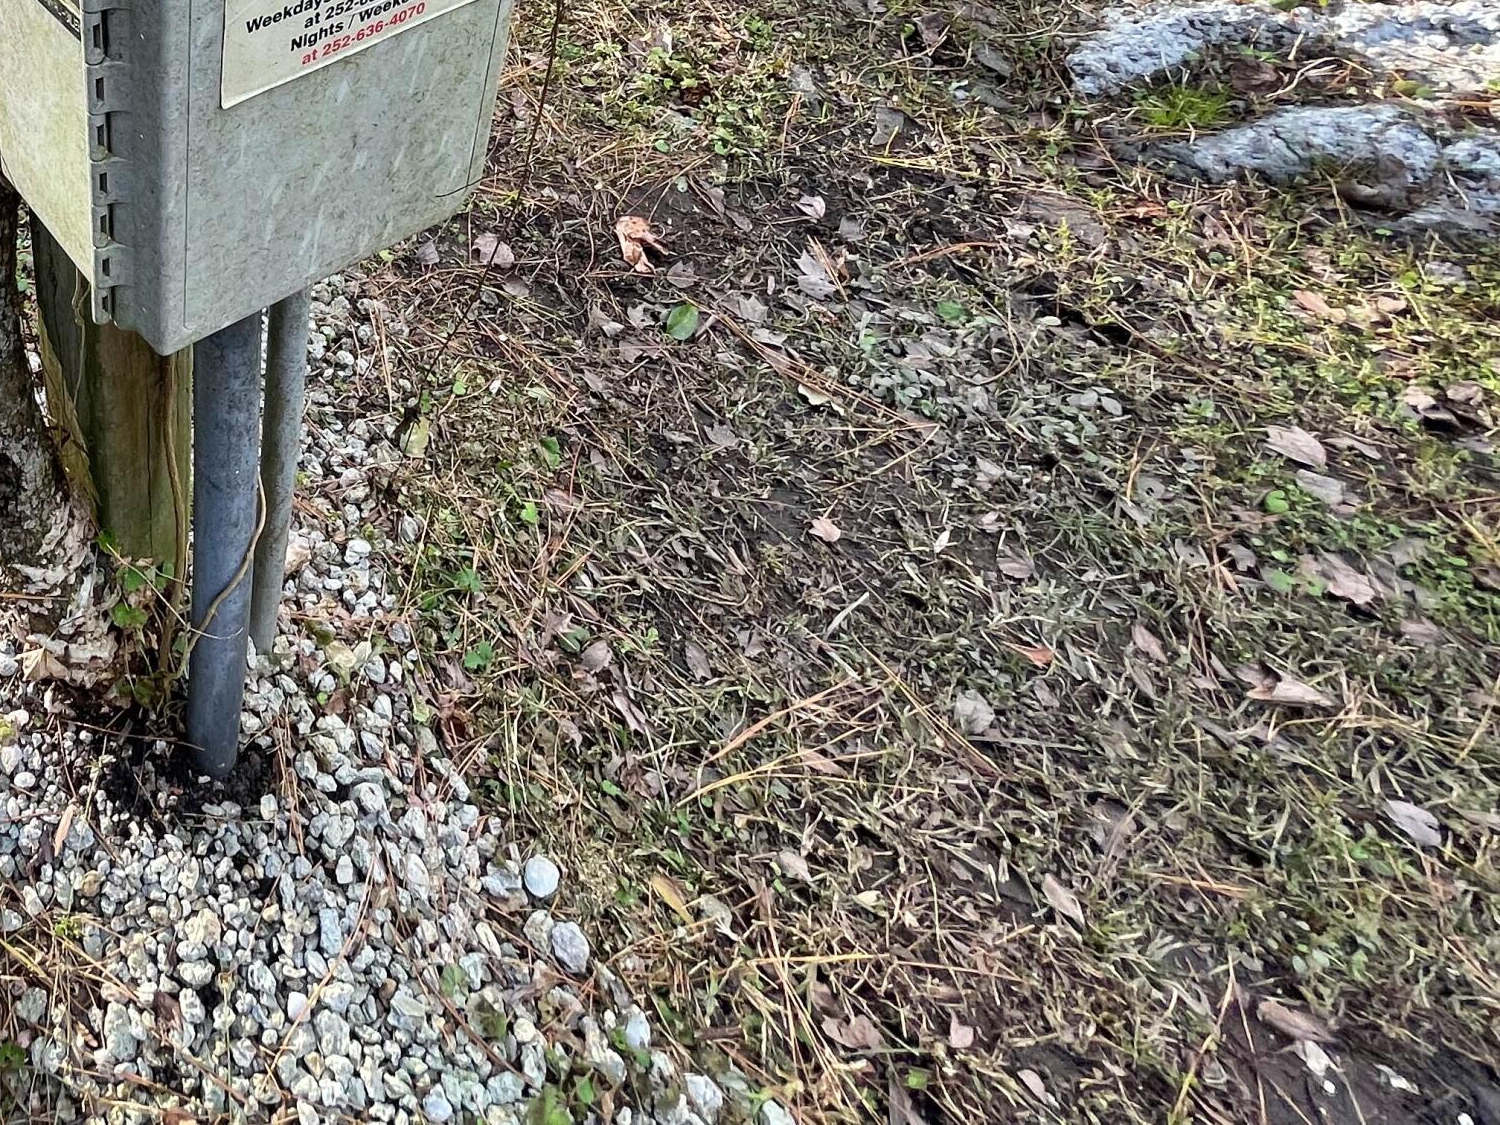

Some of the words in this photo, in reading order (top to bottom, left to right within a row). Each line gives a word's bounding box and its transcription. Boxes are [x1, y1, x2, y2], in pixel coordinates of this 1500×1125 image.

[301, 48, 318, 64] at
[322, 2, 426, 57] 252-636-4070
[304, 10, 321, 28] at
[290, 21, 344, 52] Nights
